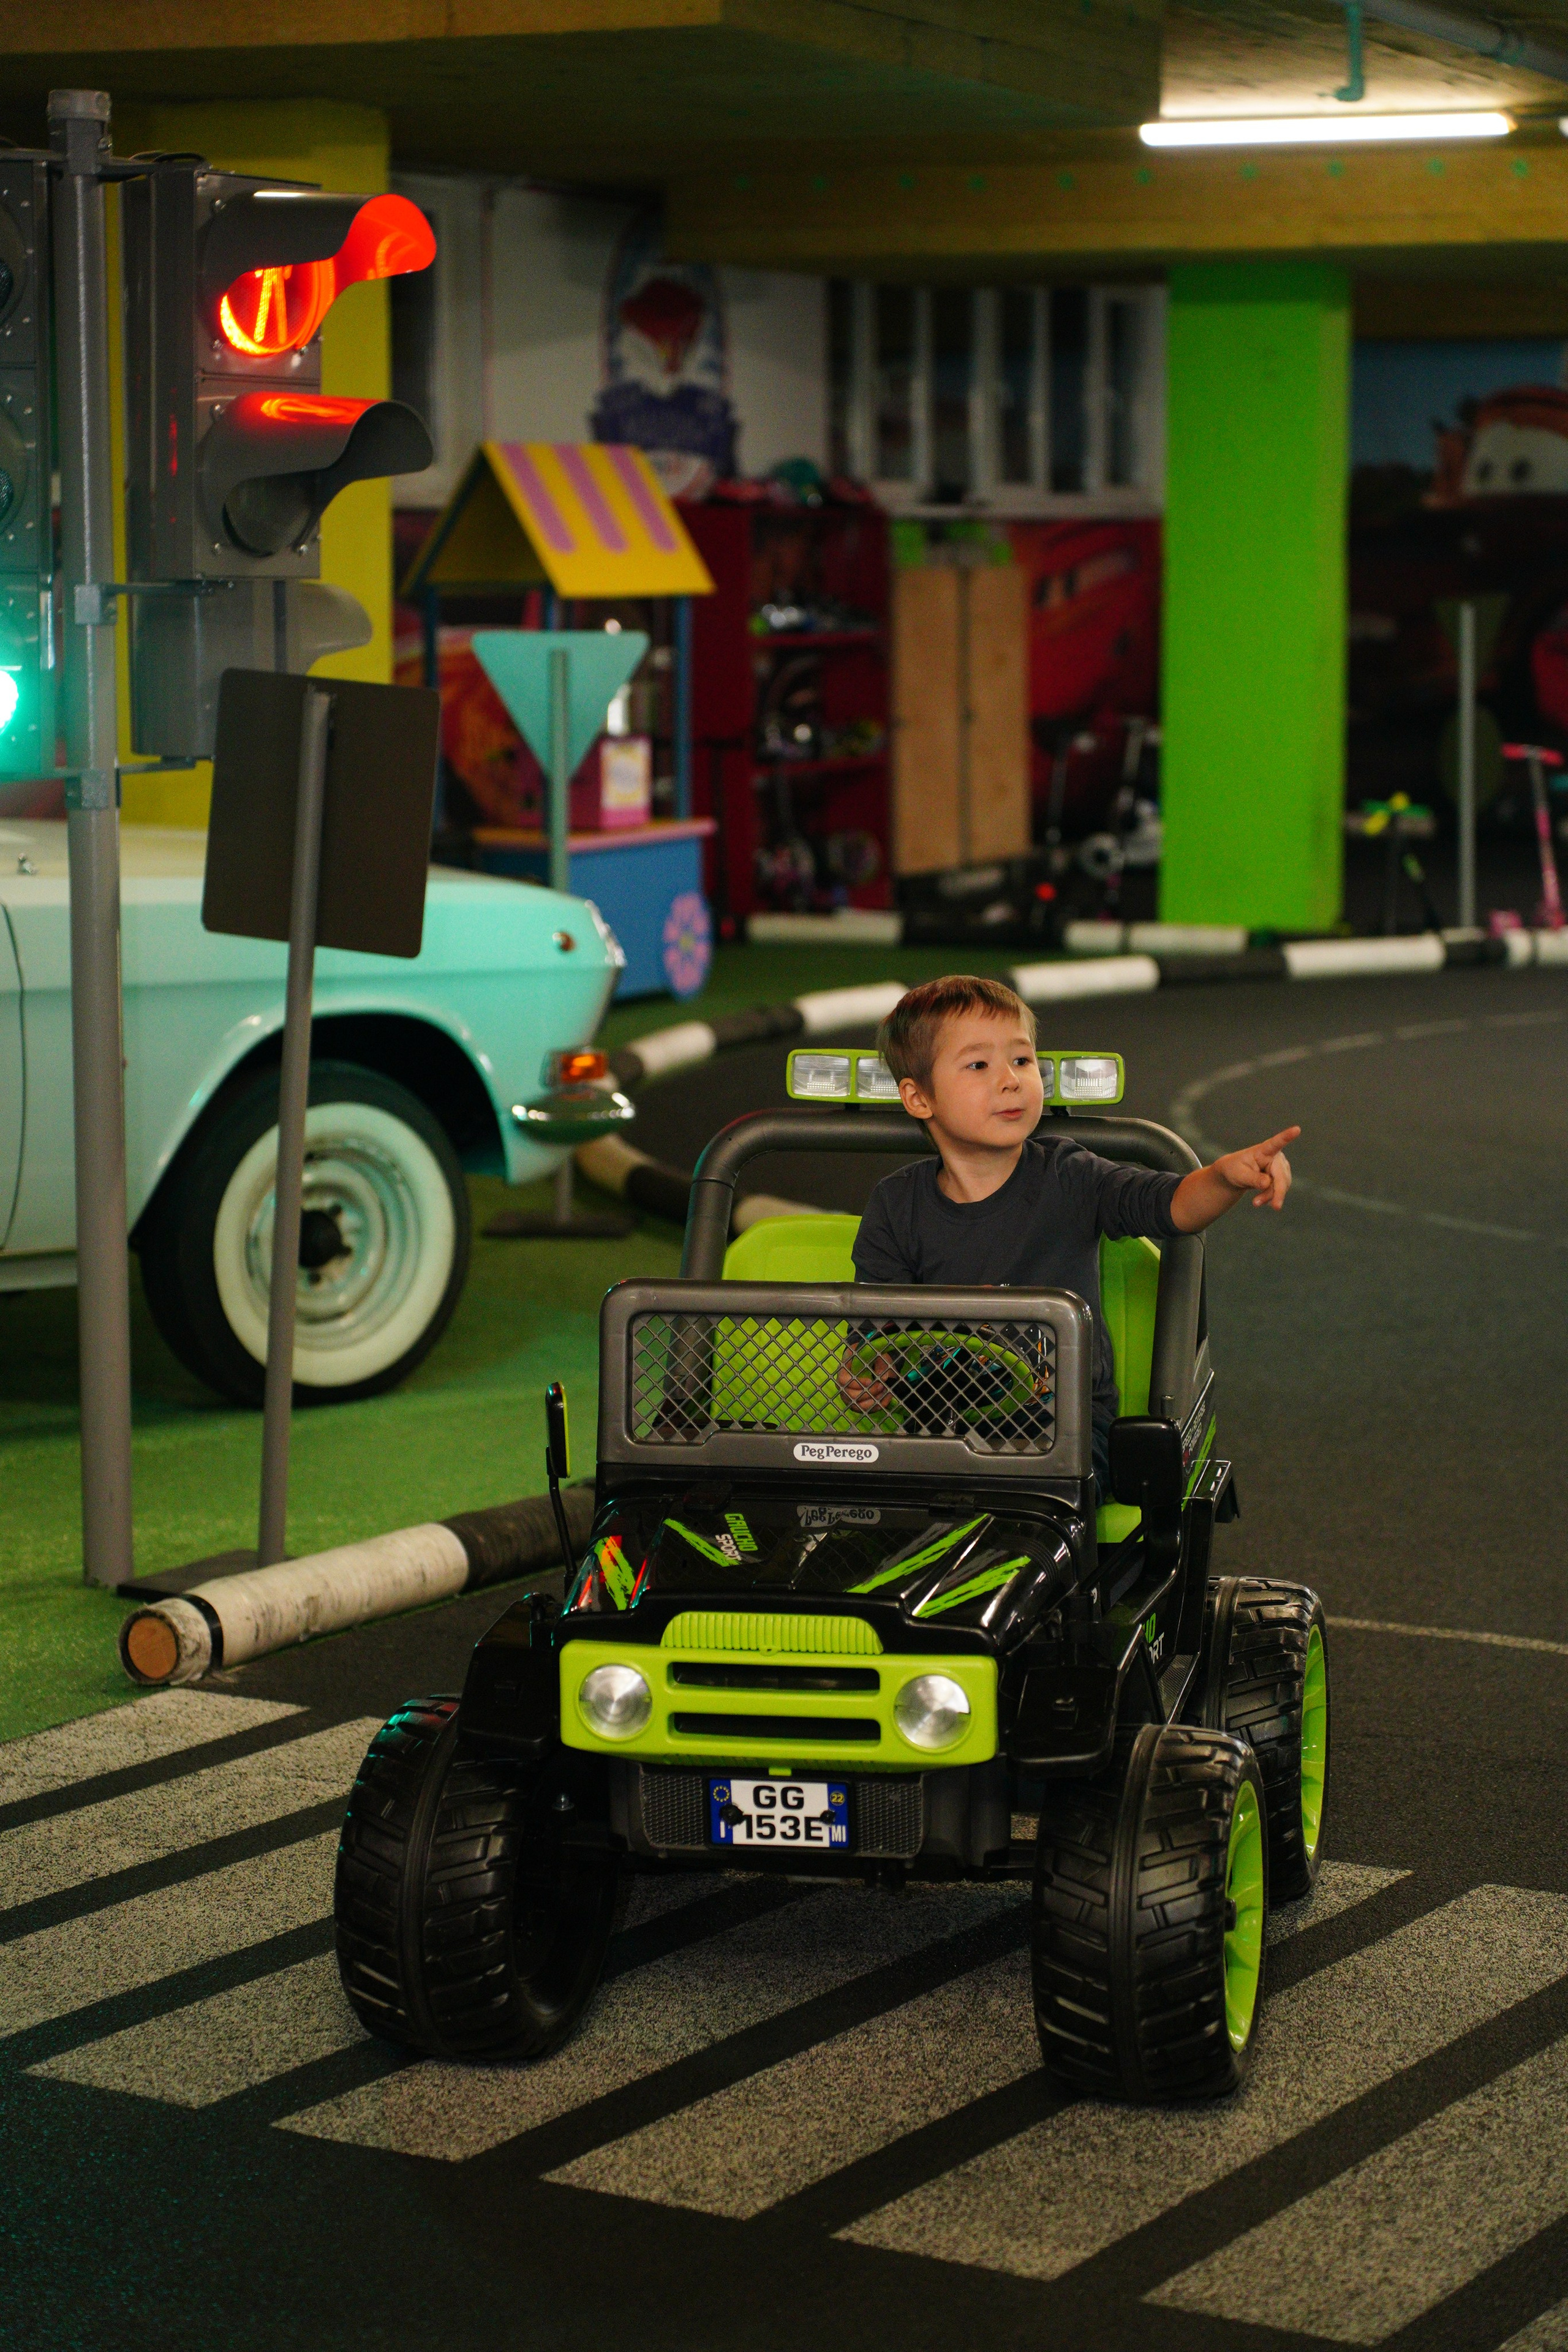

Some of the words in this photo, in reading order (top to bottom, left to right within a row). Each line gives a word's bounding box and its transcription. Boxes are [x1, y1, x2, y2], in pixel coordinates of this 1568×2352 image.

[801, 1444, 873, 1461] PegPerego
[725, 1513, 758, 1551] GAUCHO
[715, 1533, 742, 1561] SPORT
[752, 1785, 805, 1810] GG
[831, 1793, 844, 1803] 22
[742, 1814, 824, 1842] 153E
[831, 1824, 846, 1843] MI
